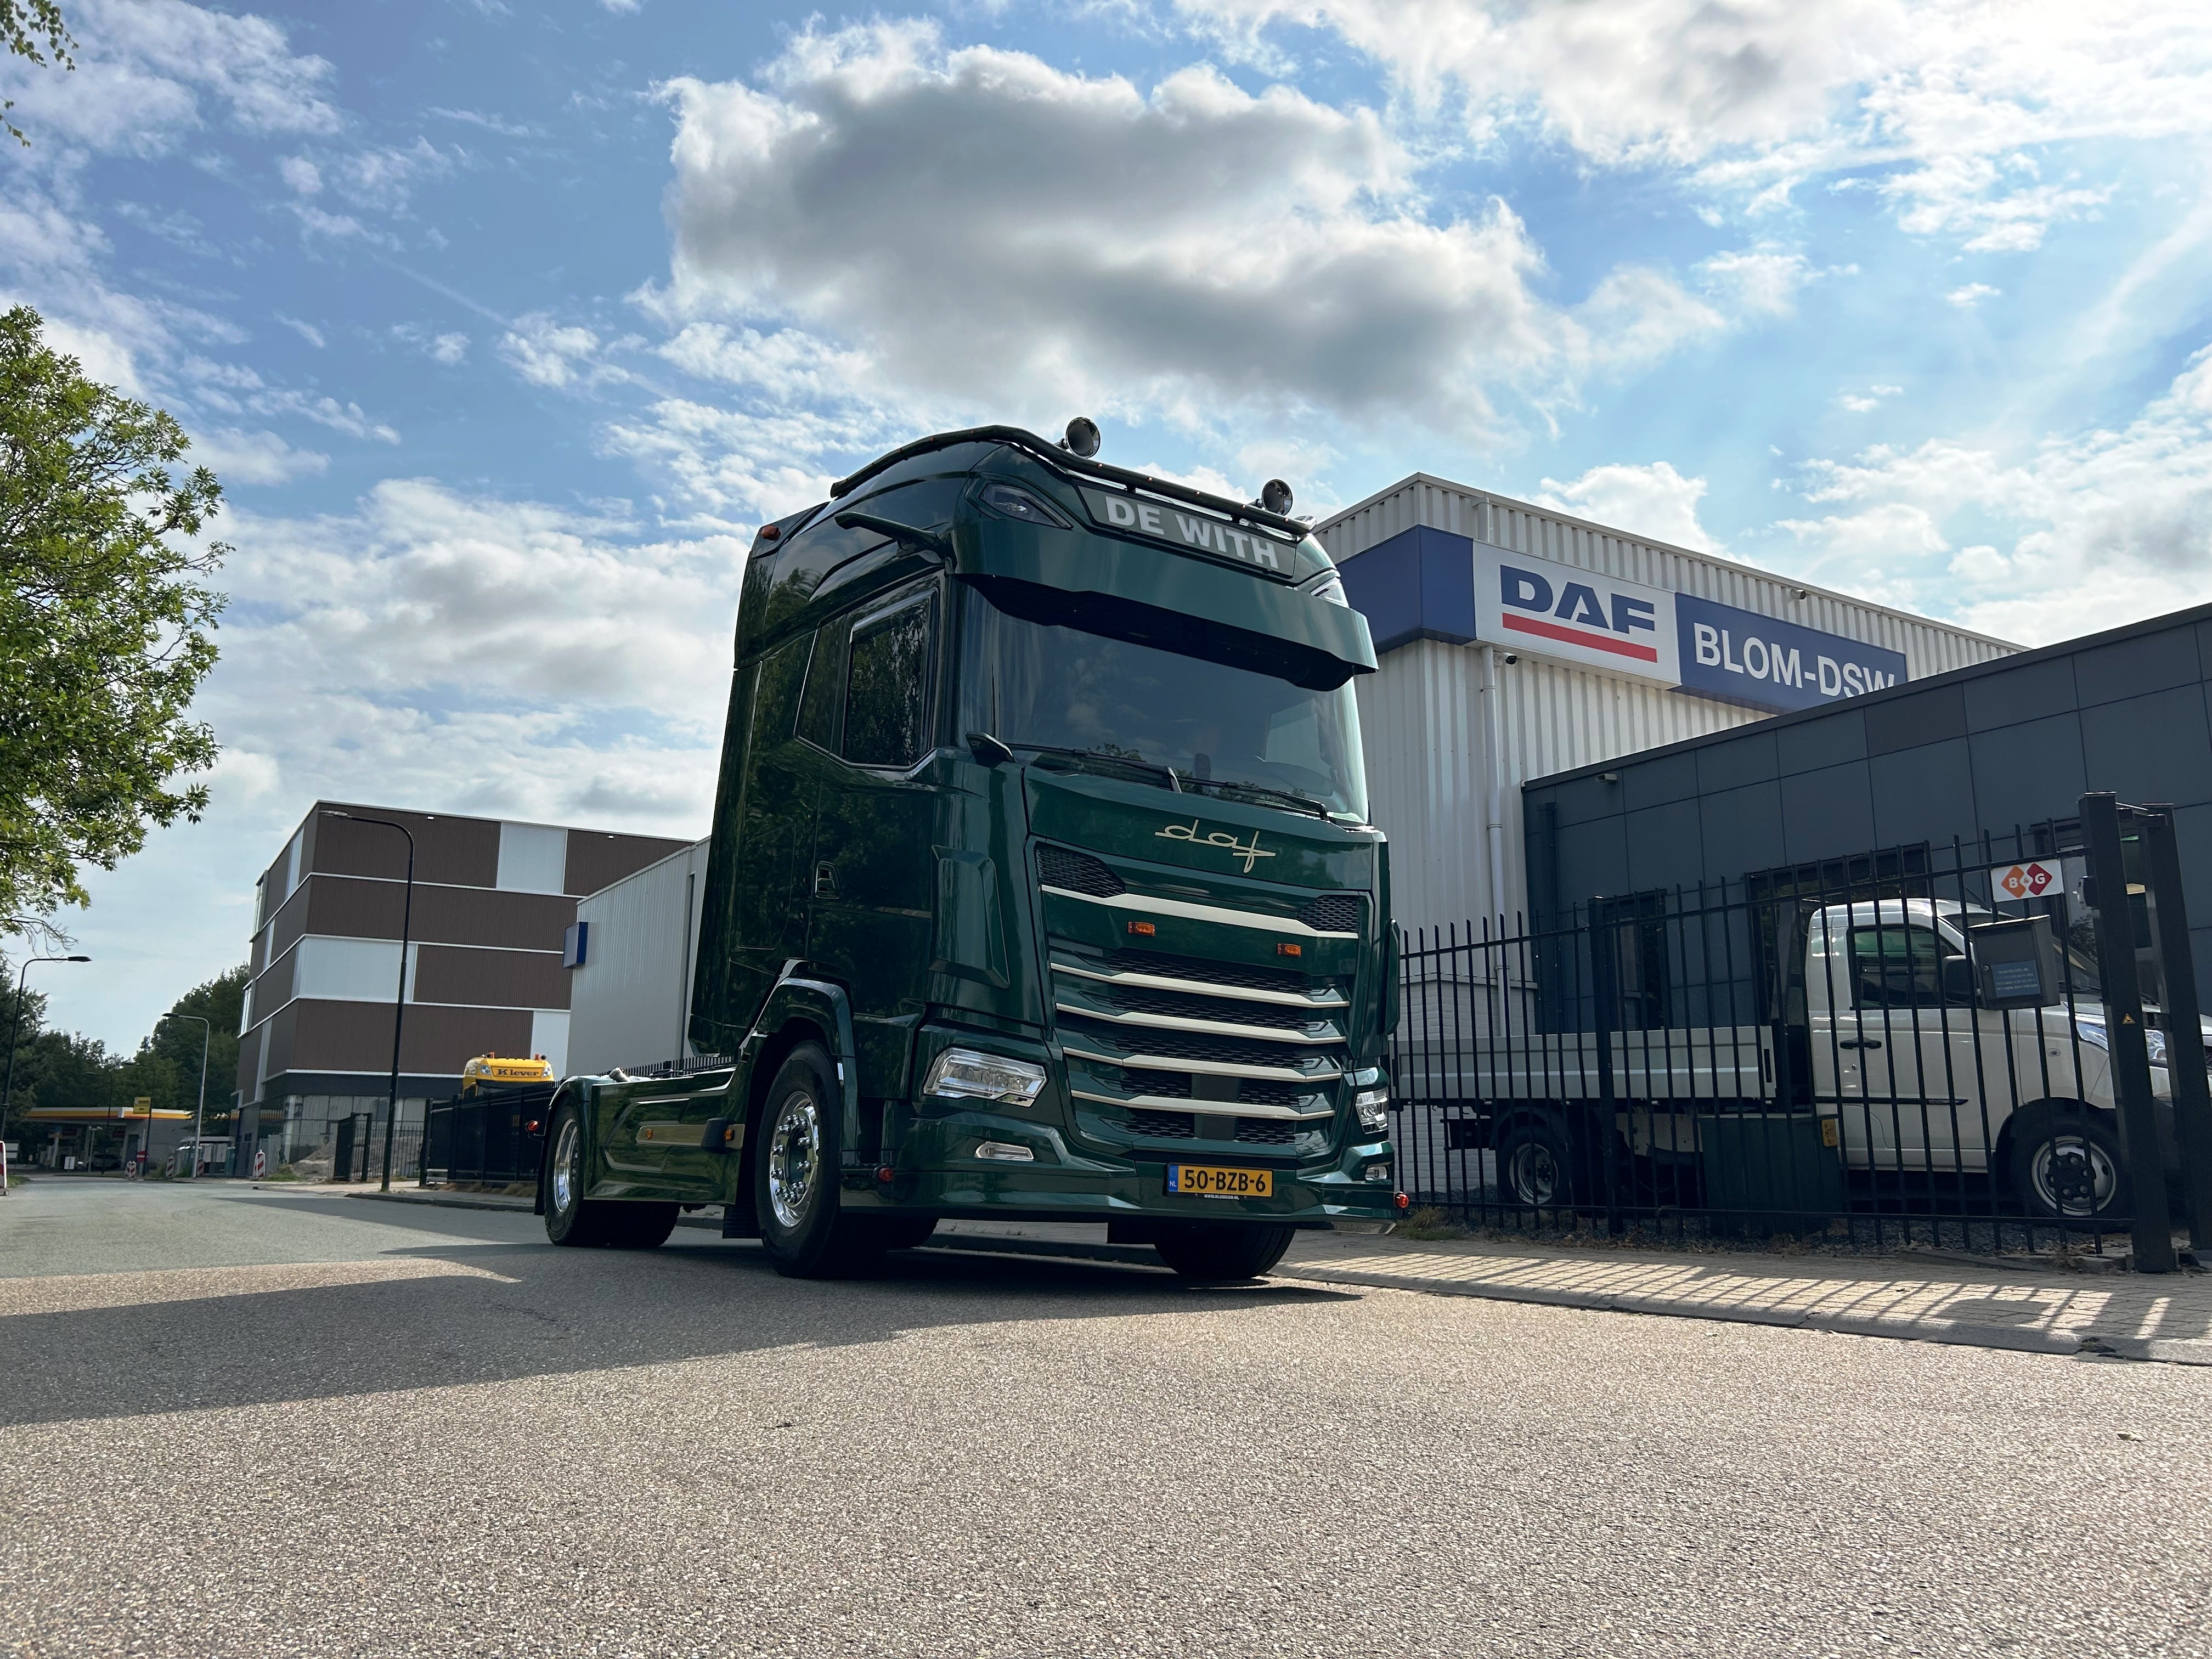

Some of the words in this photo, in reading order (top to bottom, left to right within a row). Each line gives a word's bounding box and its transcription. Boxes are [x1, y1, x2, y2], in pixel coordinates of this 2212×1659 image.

[1105, 495, 1164, 535] DE
[1175, 514, 1278, 569] WITH
[1500, 565, 1655, 635] DAF
[1184, 1169, 1266, 1193] 50-BZB-6
